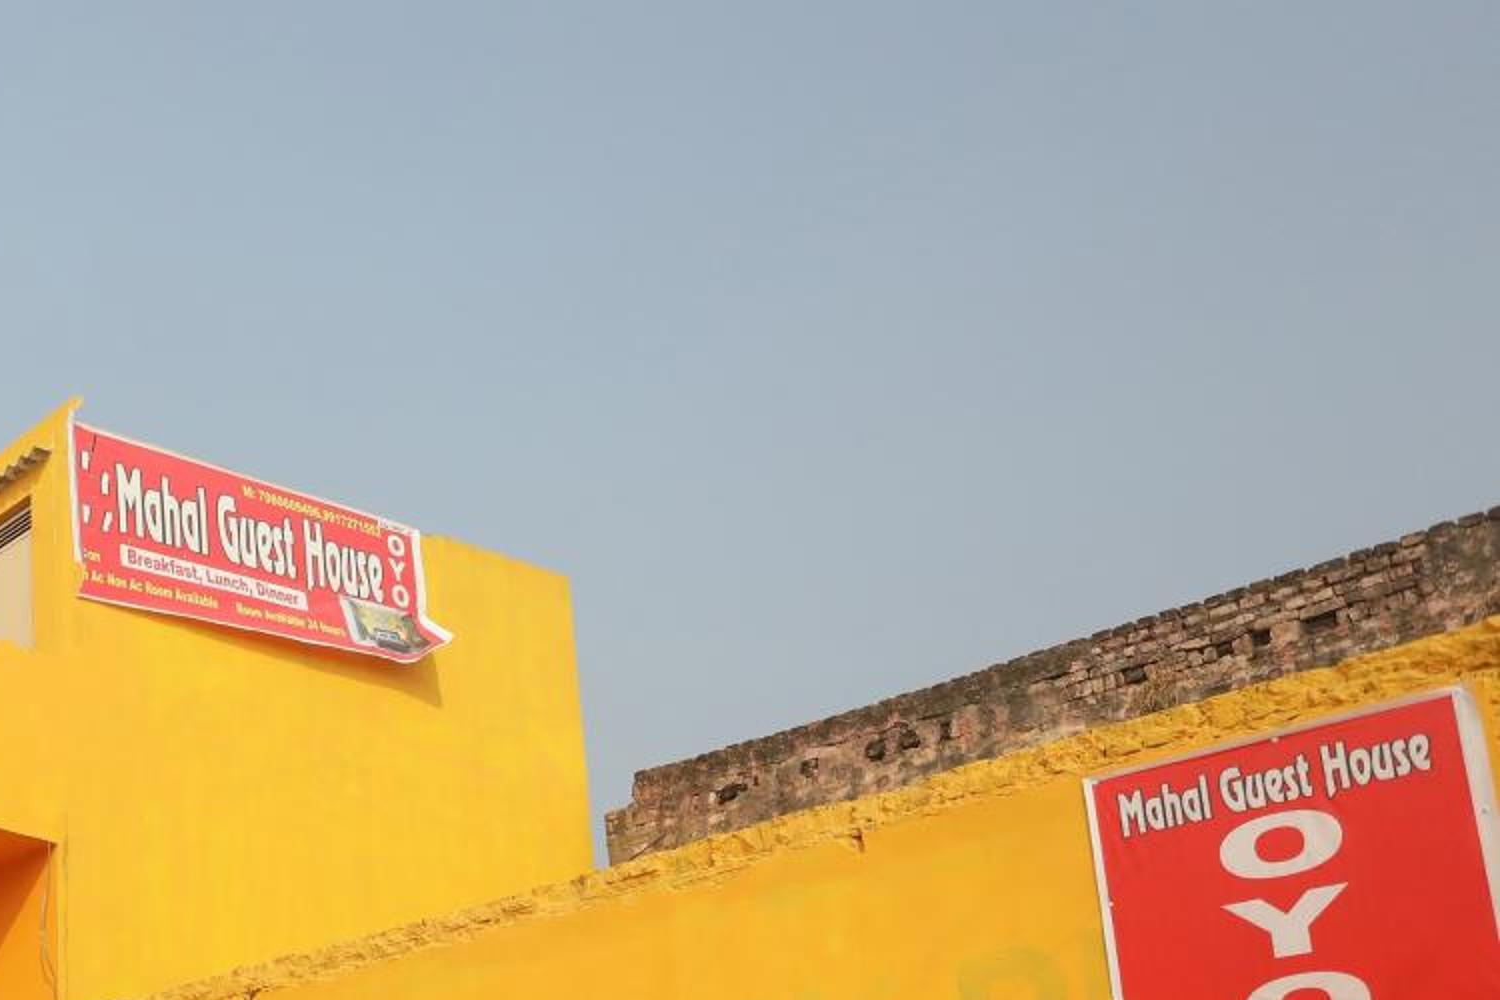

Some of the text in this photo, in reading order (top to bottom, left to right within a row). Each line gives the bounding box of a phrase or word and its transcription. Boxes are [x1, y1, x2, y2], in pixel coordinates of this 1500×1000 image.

[115, 463, 209, 556] Mahal
[217, 495, 297, 579] Guest
[303, 519, 384, 602] House
[387, 534, 410, 609] OYO
[128, 550, 203, 582] Breakfast,
[256, 582, 298, 605] Dinner
[1117, 734, 1432, 838] Mahal Guest House
